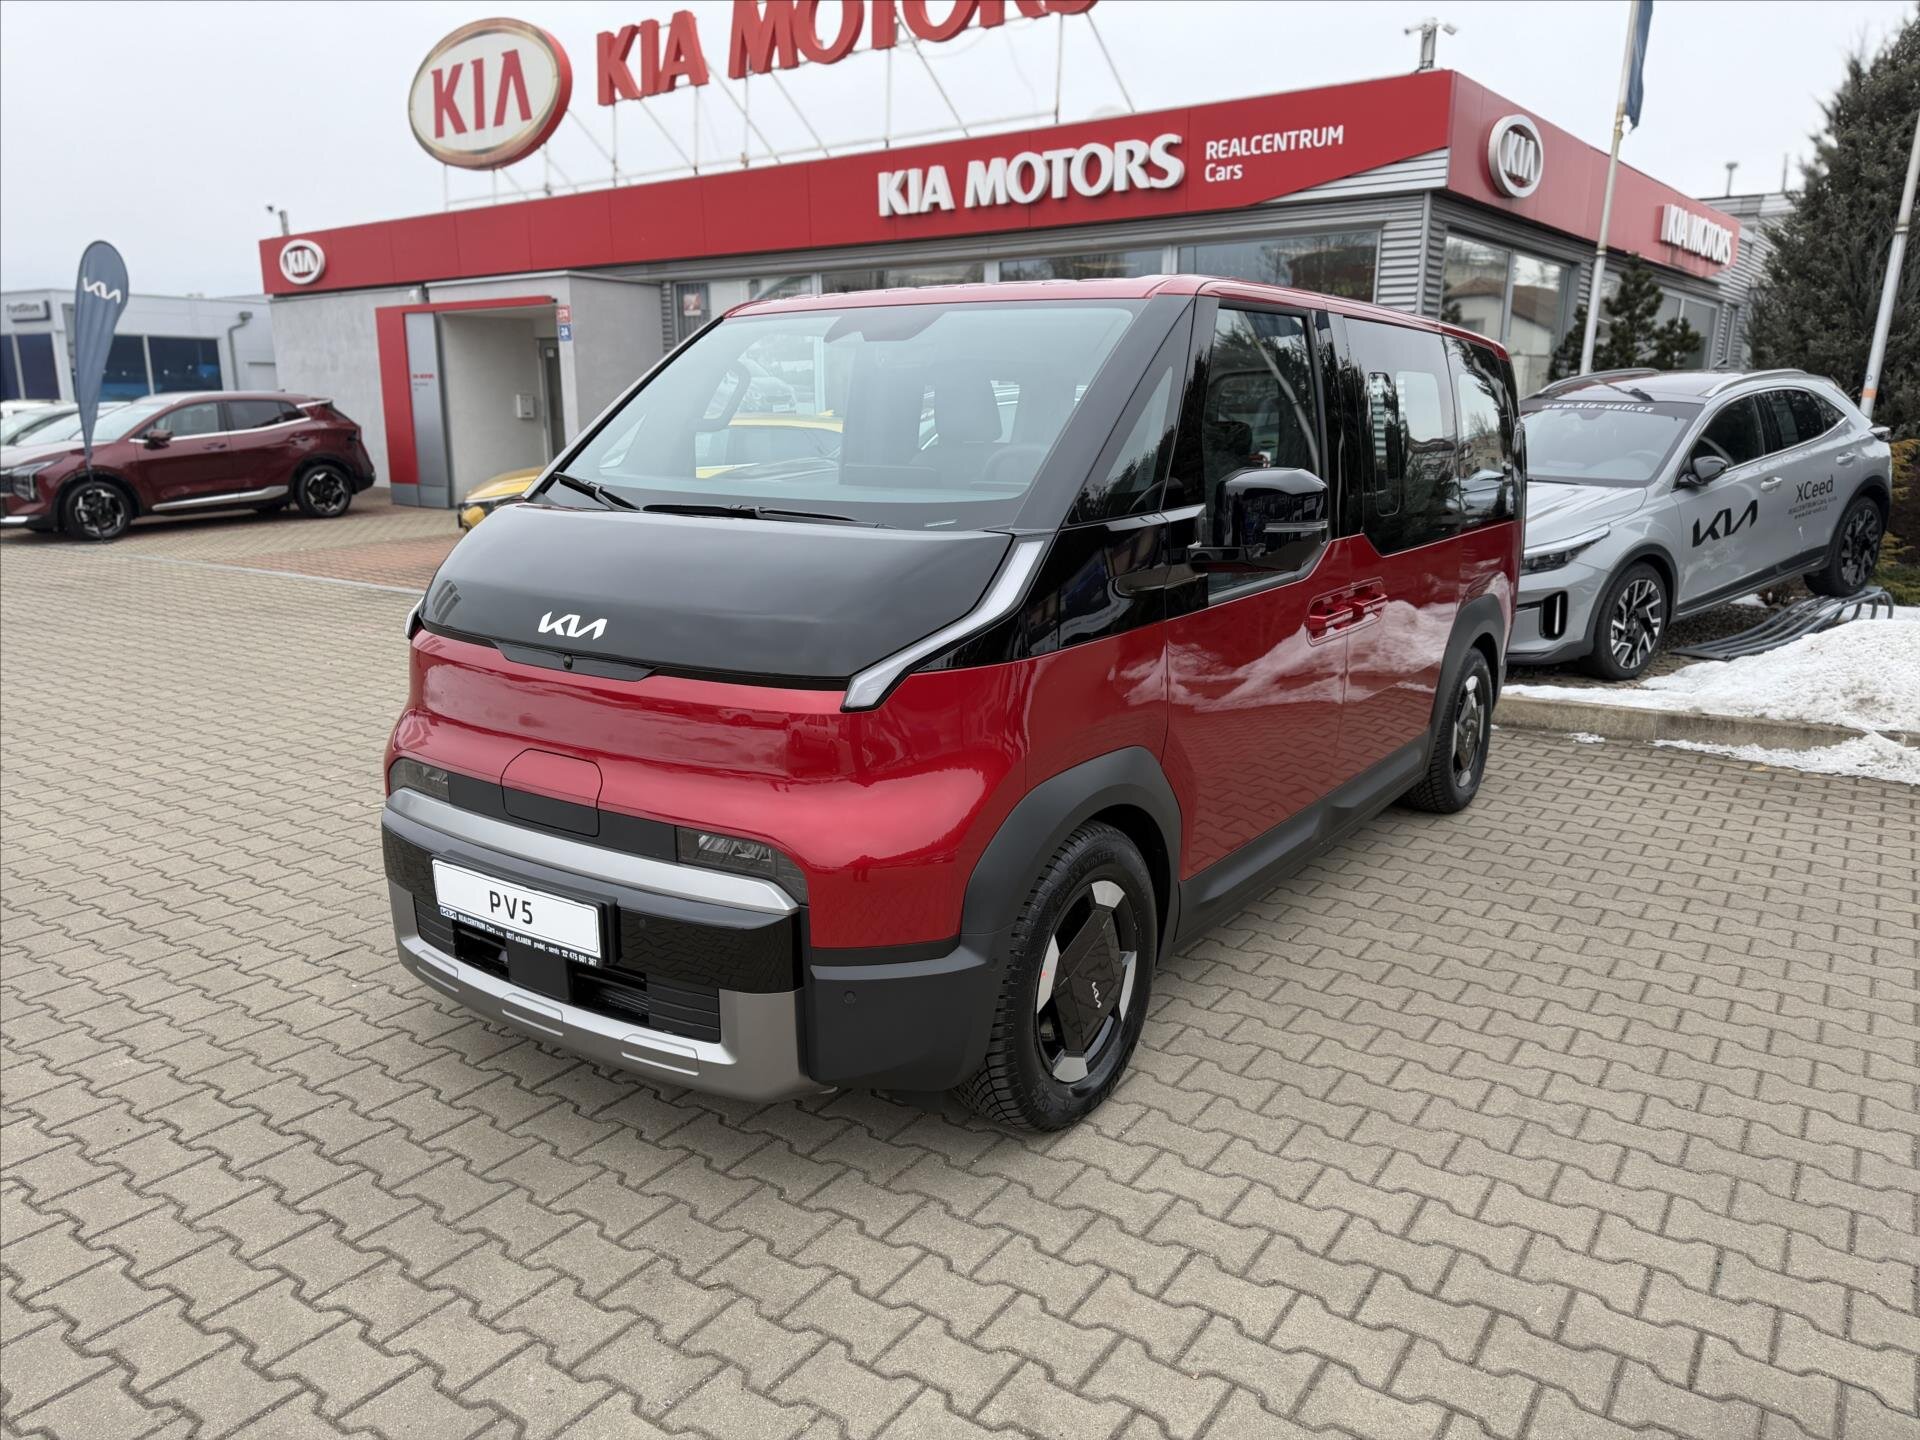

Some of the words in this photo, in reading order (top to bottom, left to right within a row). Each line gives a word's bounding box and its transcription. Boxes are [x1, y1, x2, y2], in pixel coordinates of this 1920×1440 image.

[597, 10, 709, 106] KIA
[728, 0, 1100, 79] MOT
[431, 49, 533, 139] KIA
[1205, 125, 1345, 160] REALCENTRUM
[1504, 130, 1536, 183] KIA
[877, 165, 956, 217] KIA
[964, 133, 1186, 209] MOTORS
[1204, 163, 1244, 183] Cars
[1662, 203, 1688, 249] KIA
[1687, 213, 1734, 265] MOTORS
[286, 249, 315, 274] KIA
[1796, 474, 1834, 503] XCeed
[1692, 499, 1758, 548] KIA
[538, 611, 608, 640] KIA
[490, 890, 533, 925] PV5
